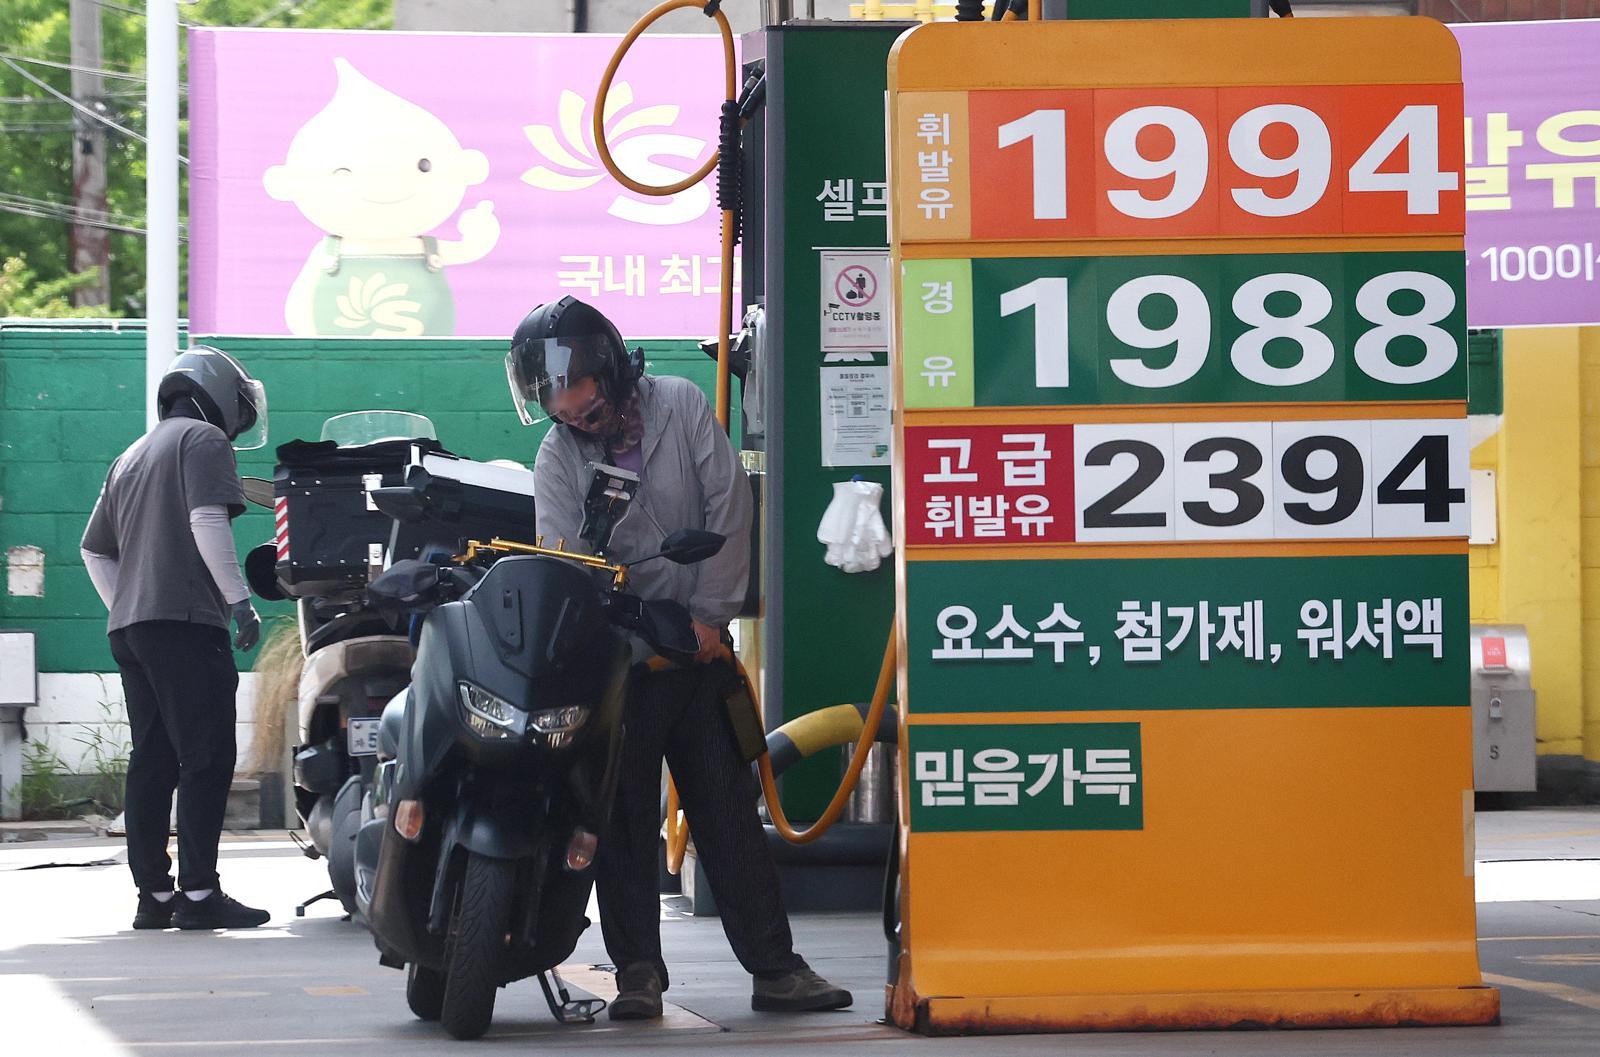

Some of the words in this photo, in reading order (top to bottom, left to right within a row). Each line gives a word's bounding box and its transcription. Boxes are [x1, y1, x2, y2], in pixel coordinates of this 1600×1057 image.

[917, 113, 953, 220] 휘발유
[998, 103, 1459, 219] 1994
[815, 178, 887, 222] 셀프
[557, 254, 646, 297] 국내
[1481, 242, 1600, 282] 100이
[1000, 271, 1458, 388] 1988
[923, 433, 1052, 487] 고급
[1083, 435, 1466, 529] 2394
[924, 494, 1054, 538] 휘발유
[931, 602, 1101, 666] 요소수,
[1114, 599, 1282, 664] 첨가제,
[1297, 597, 1443, 660] 워셔액
[915, 748, 1137, 806] 믿음가득
